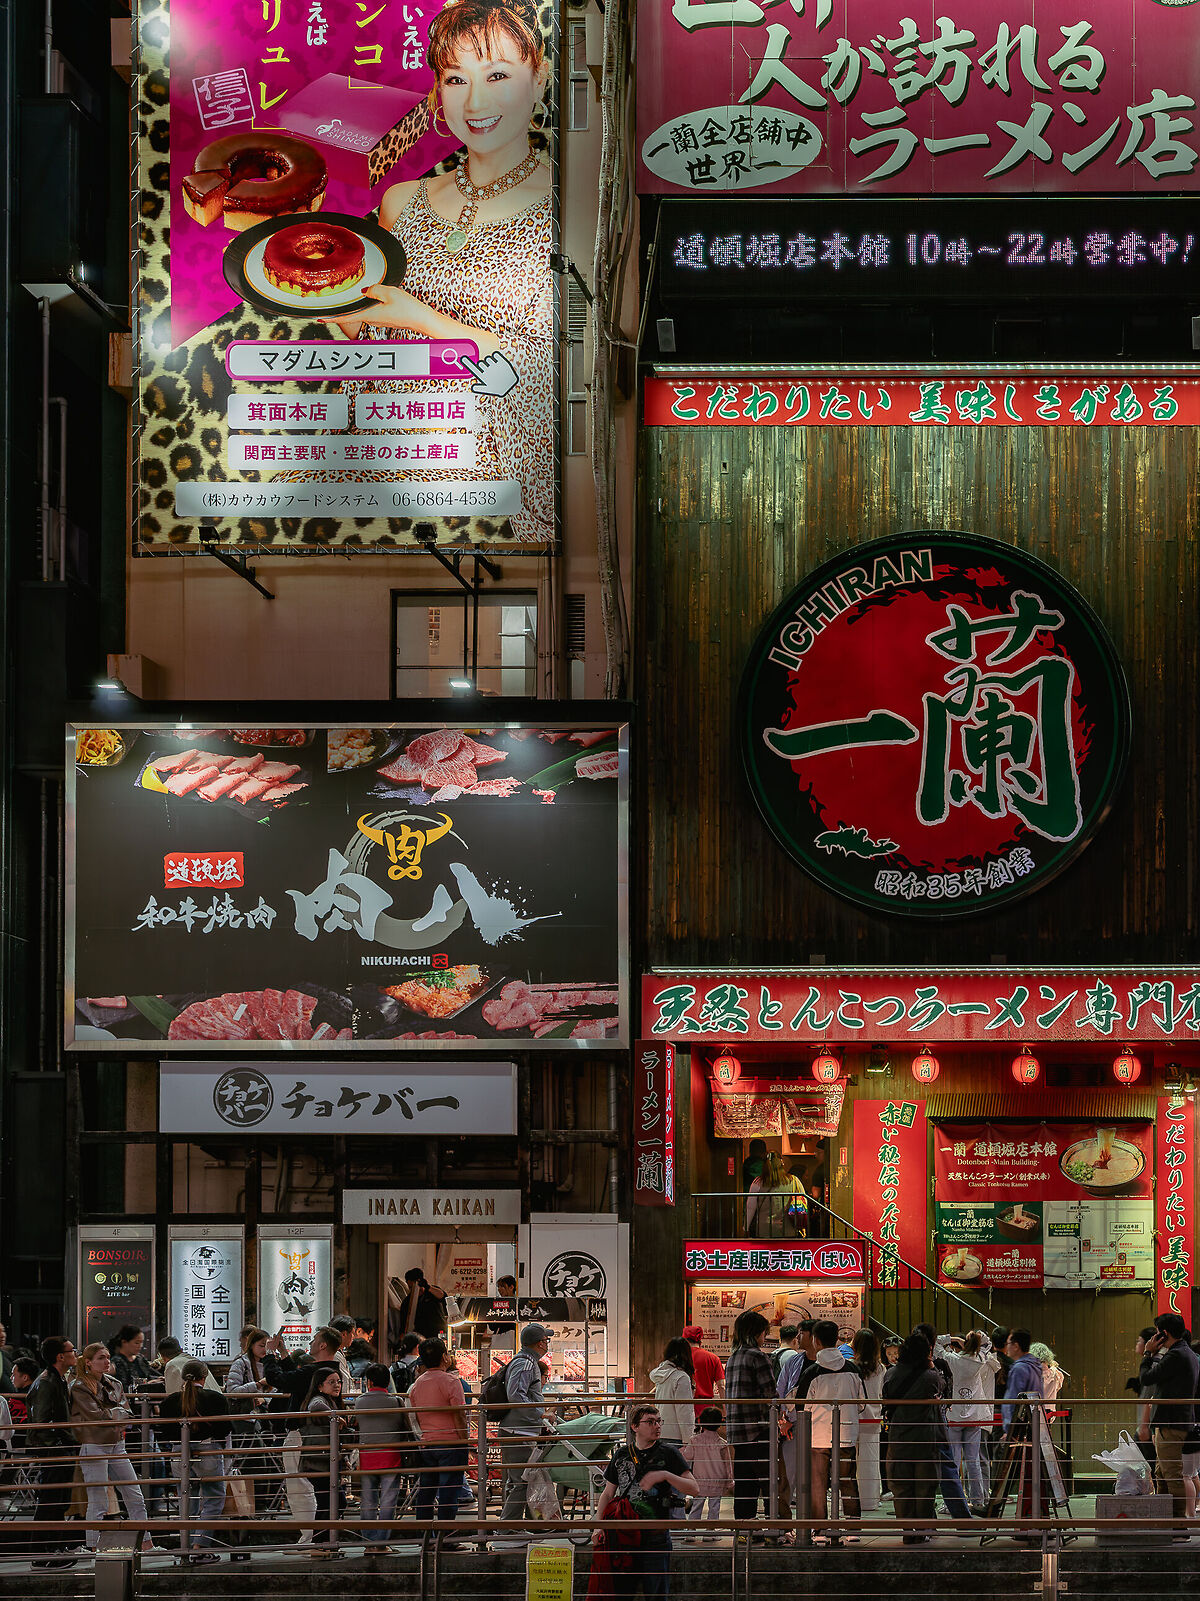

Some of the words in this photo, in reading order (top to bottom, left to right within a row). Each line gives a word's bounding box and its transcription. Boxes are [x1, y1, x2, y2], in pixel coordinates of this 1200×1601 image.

[738, 17, 1106, 107] 人が訪れる
[326, 131, 371, 148] SHINCO
[329, 126, 376, 143] MADAME
[647, 114, 814, 161] 一蘭全店舗中
[851, 89, 1200, 184] ラーメン店
[686, 152, 784, 188] 世界一
[672, 231, 892, 271] 道頓堀店本館
[259, 347, 398, 373] マダムシンコ
[247, 400, 329, 423] 箕面本店
[364, 400, 467, 422] 大丸梅田店
[670, 384, 892, 424] こだわりたい
[908, 381, 1181, 425] 美味しさがある
[243, 443, 460, 462] 関西主要駅・空港のお土産店
[391, 490, 497, 509] 06-6864-4538
[768, 549, 935, 672] ICHIRAN
[763, 590, 1085, 842] 一蘭
[166, 856, 244, 885] 道頓堀
[874, 845, 1037, 901] 昭和35年創業
[284, 848, 565, 946] 肉八
[131, 891, 279, 934] 和牛焼肉
[360, 954, 432, 968] NIKUHACHI
[280, 1081, 460, 1121] チョケバー
[940, 1142, 967, 1157] 一蘭
[973, 1141, 1058, 1158] 道頓堀店本館
[957, 1158, 990, 1167] Dotonbori
[368, 1198, 421, 1217] INAKA
[432, 1198, 496, 1217] KAIKAN
[112, 1228, 121, 1236] 4F
[88, 1250, 147, 1261] BONSOIR
[686, 1250, 813, 1272] お土産販売所
[820, 1251, 857, 1270] ばい
[191, 1284, 206, 1357] 国際物流
[546, 1325, 606, 1339] ョケバー
